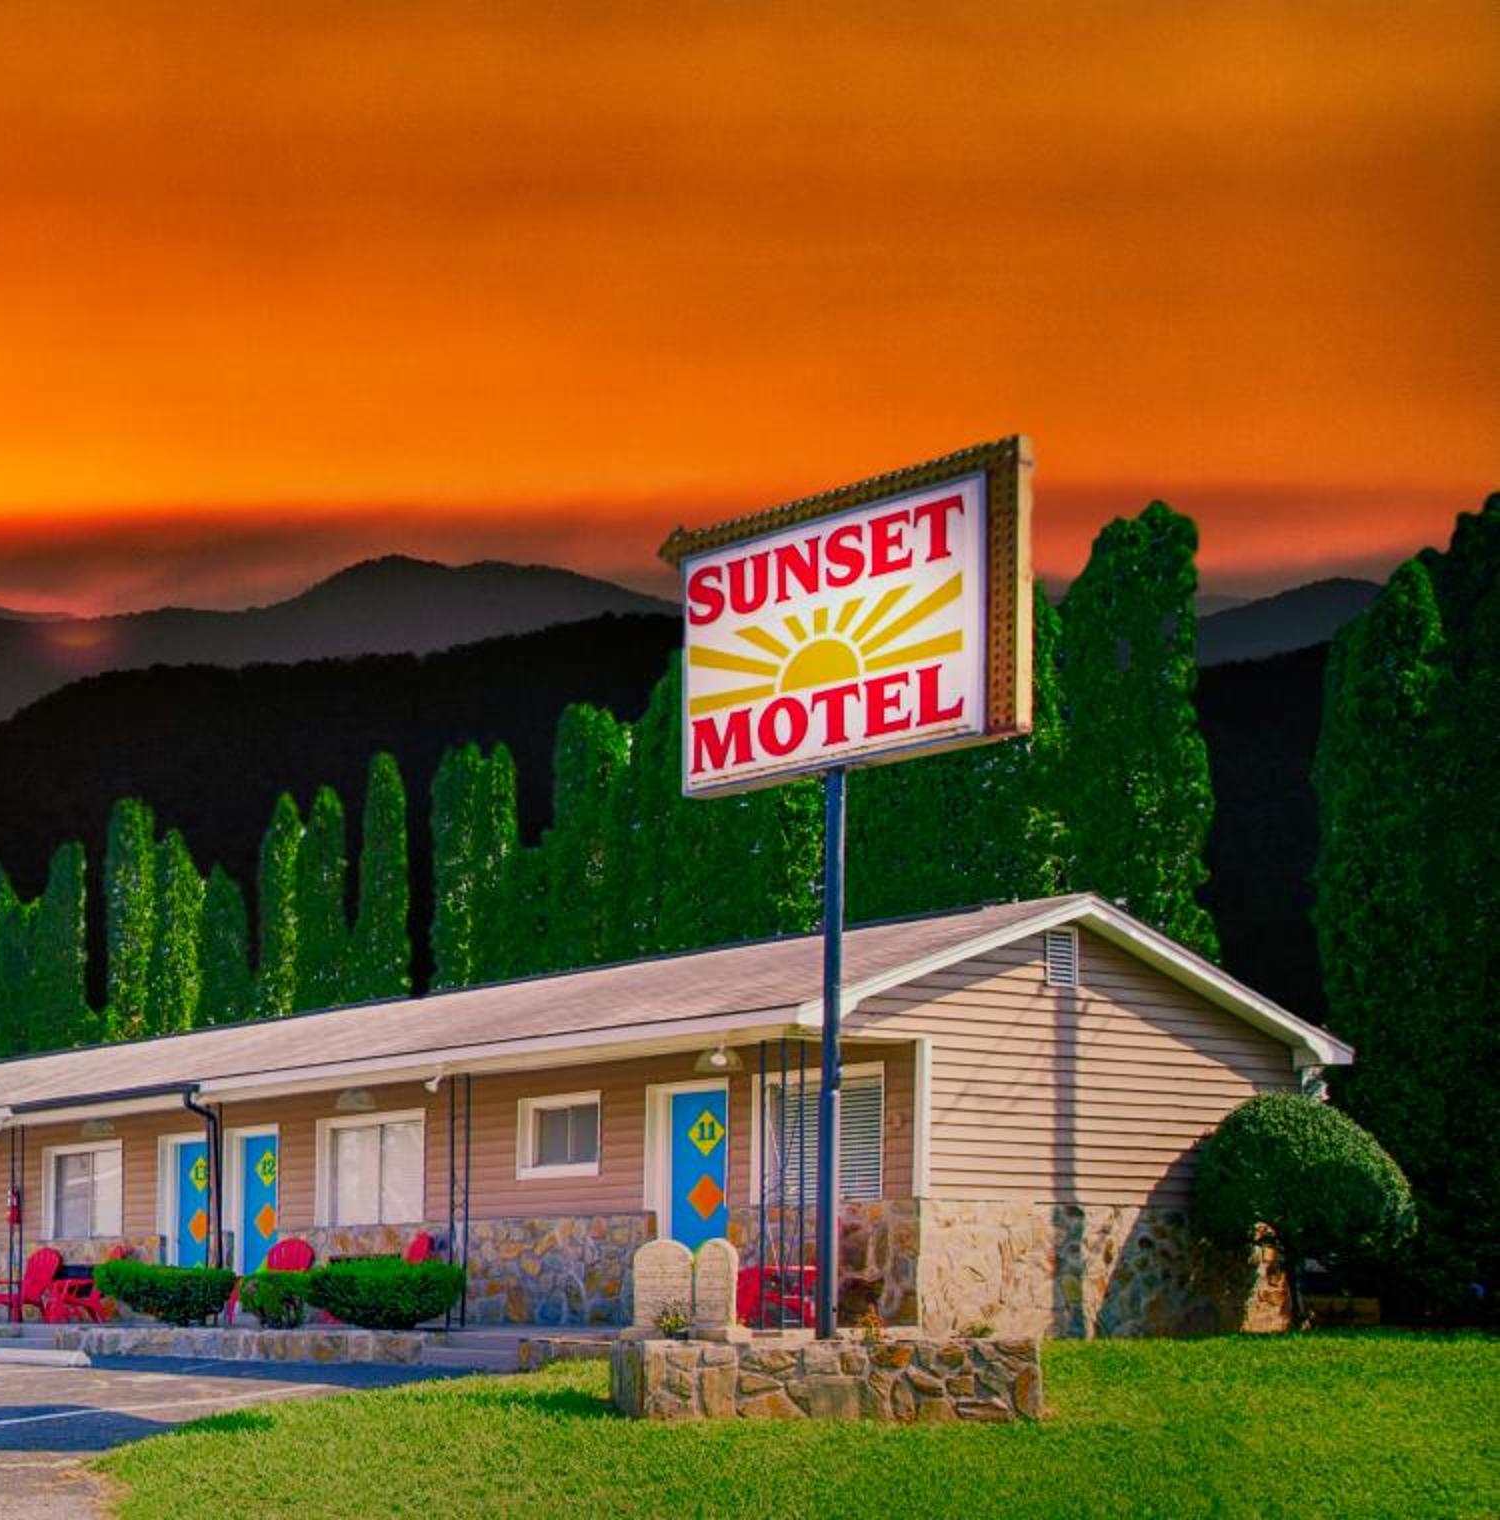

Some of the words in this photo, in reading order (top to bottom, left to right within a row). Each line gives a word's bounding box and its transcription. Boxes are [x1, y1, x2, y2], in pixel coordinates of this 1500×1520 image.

[687, 495, 965, 626] SUNSET
[691, 664, 965, 775] MOTEL
[697, 1120, 716, 1141] 11
